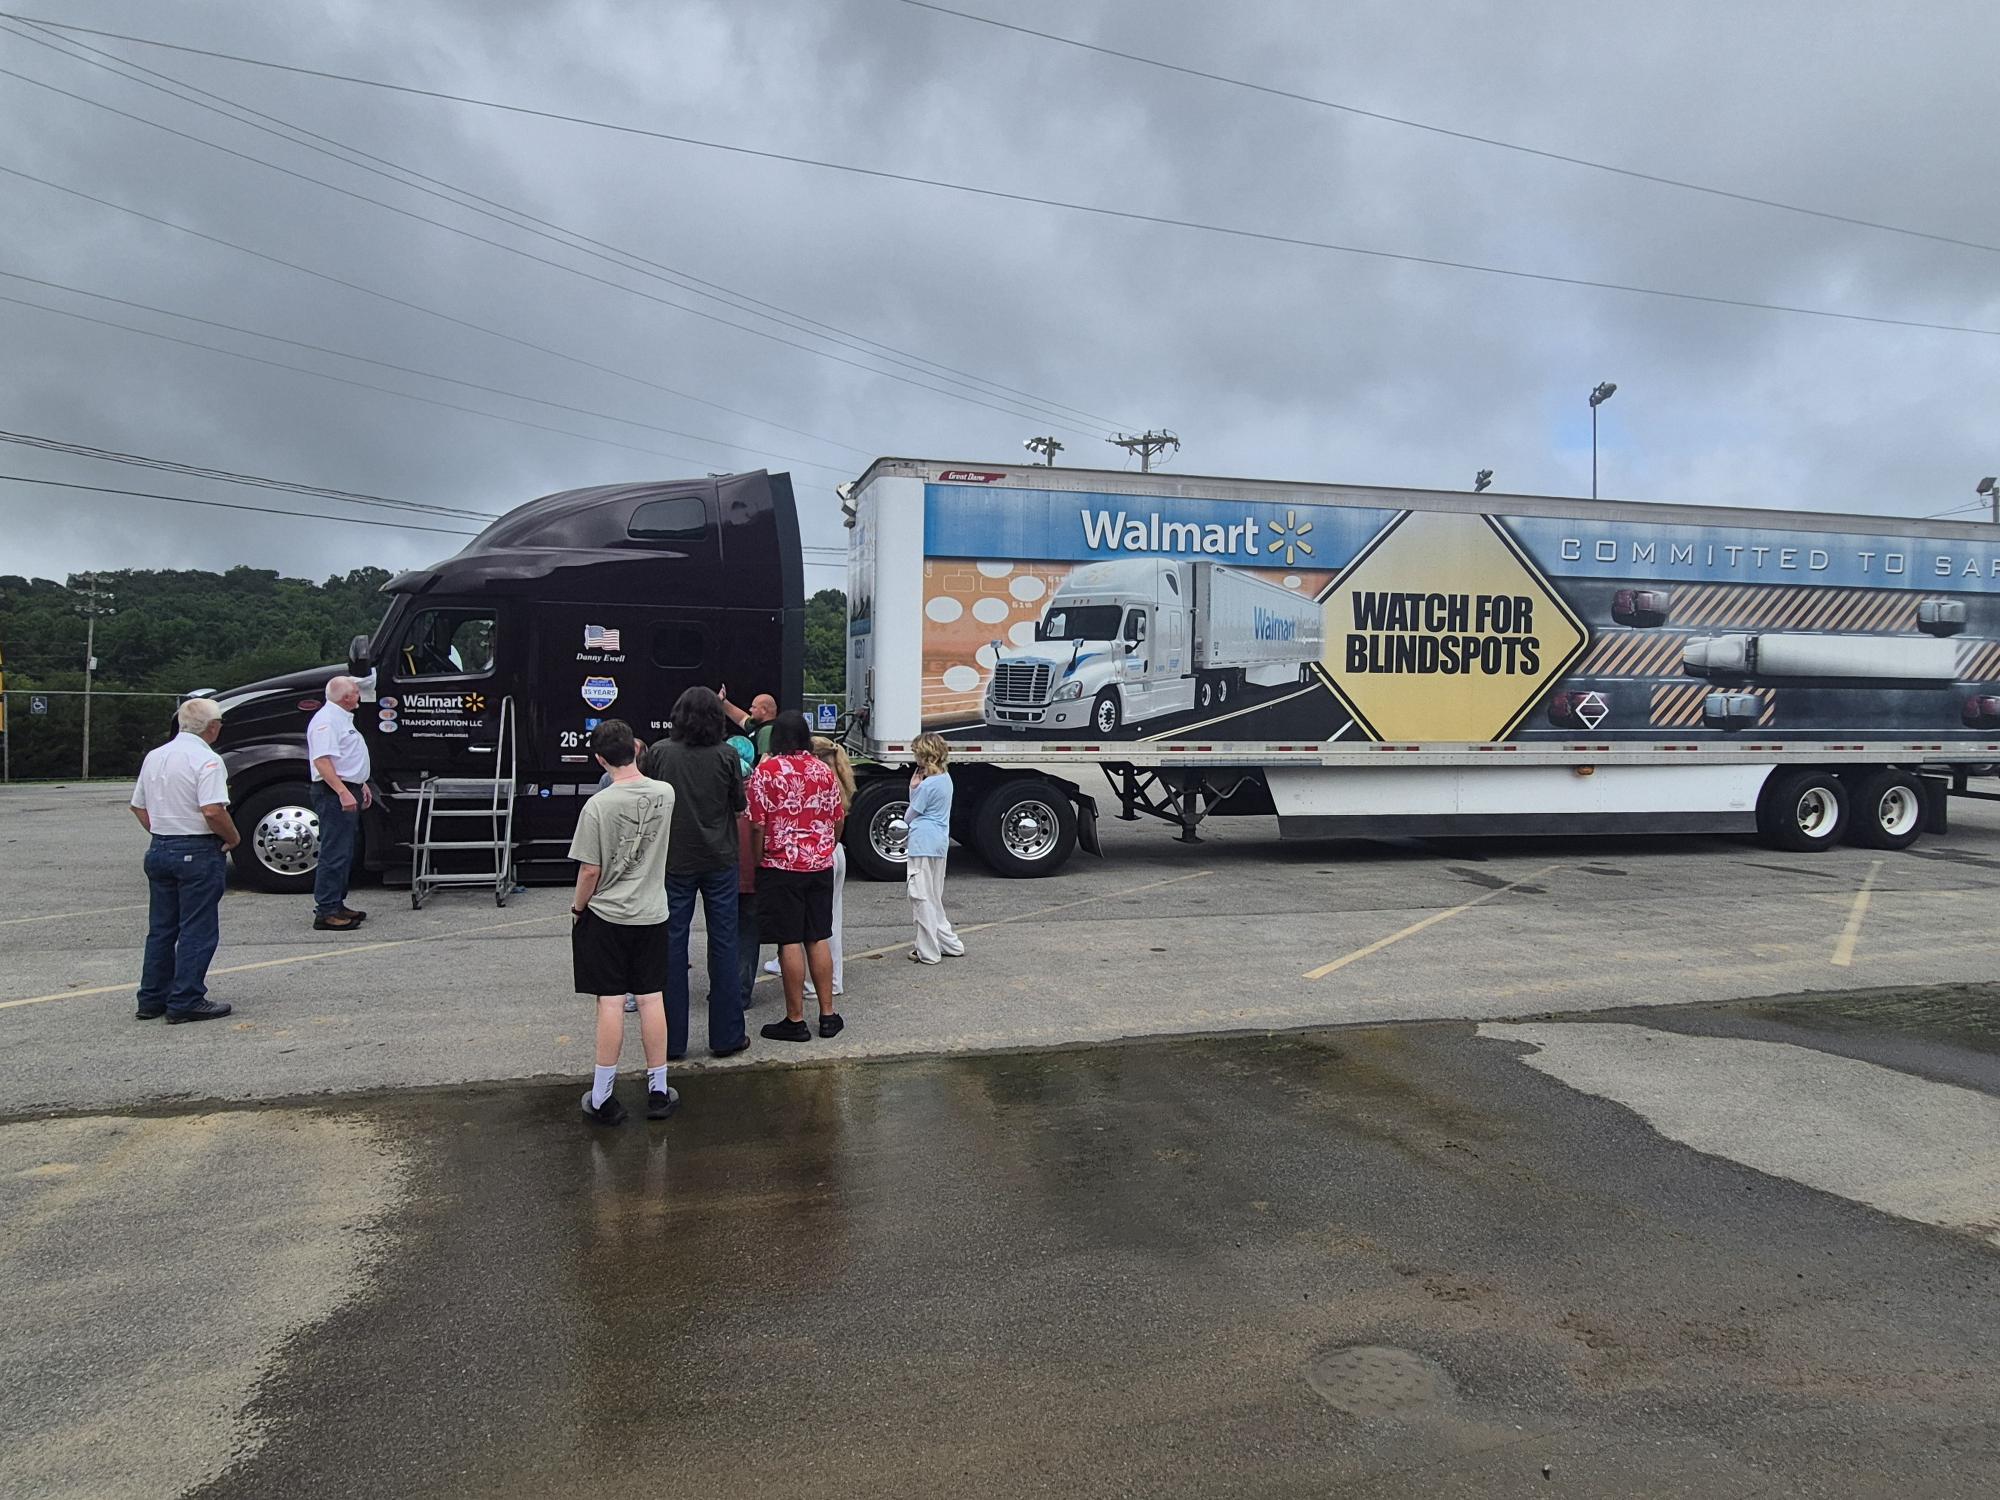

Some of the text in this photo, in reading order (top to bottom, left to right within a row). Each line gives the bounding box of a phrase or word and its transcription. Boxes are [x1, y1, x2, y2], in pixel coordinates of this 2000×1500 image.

[948, 471, 986, 482] Great Dane
[1080, 509, 1260, 556] Walmart
[1560, 538, 1830, 571] COMMITTED
[1857, 551, 1905, 574] TO
[1352, 591, 1534, 634] WATCH FOR
[575, 652, 626, 663] Danny Ewell
[1345, 633, 1540, 676] BLINDSPOTS
[592, 688, 617, 697] YEARS
[402, 694, 464, 708] Walmart
[400, 718, 483, 728] TRANSPORTATION LLC
[650, 720, 661, 729] US
